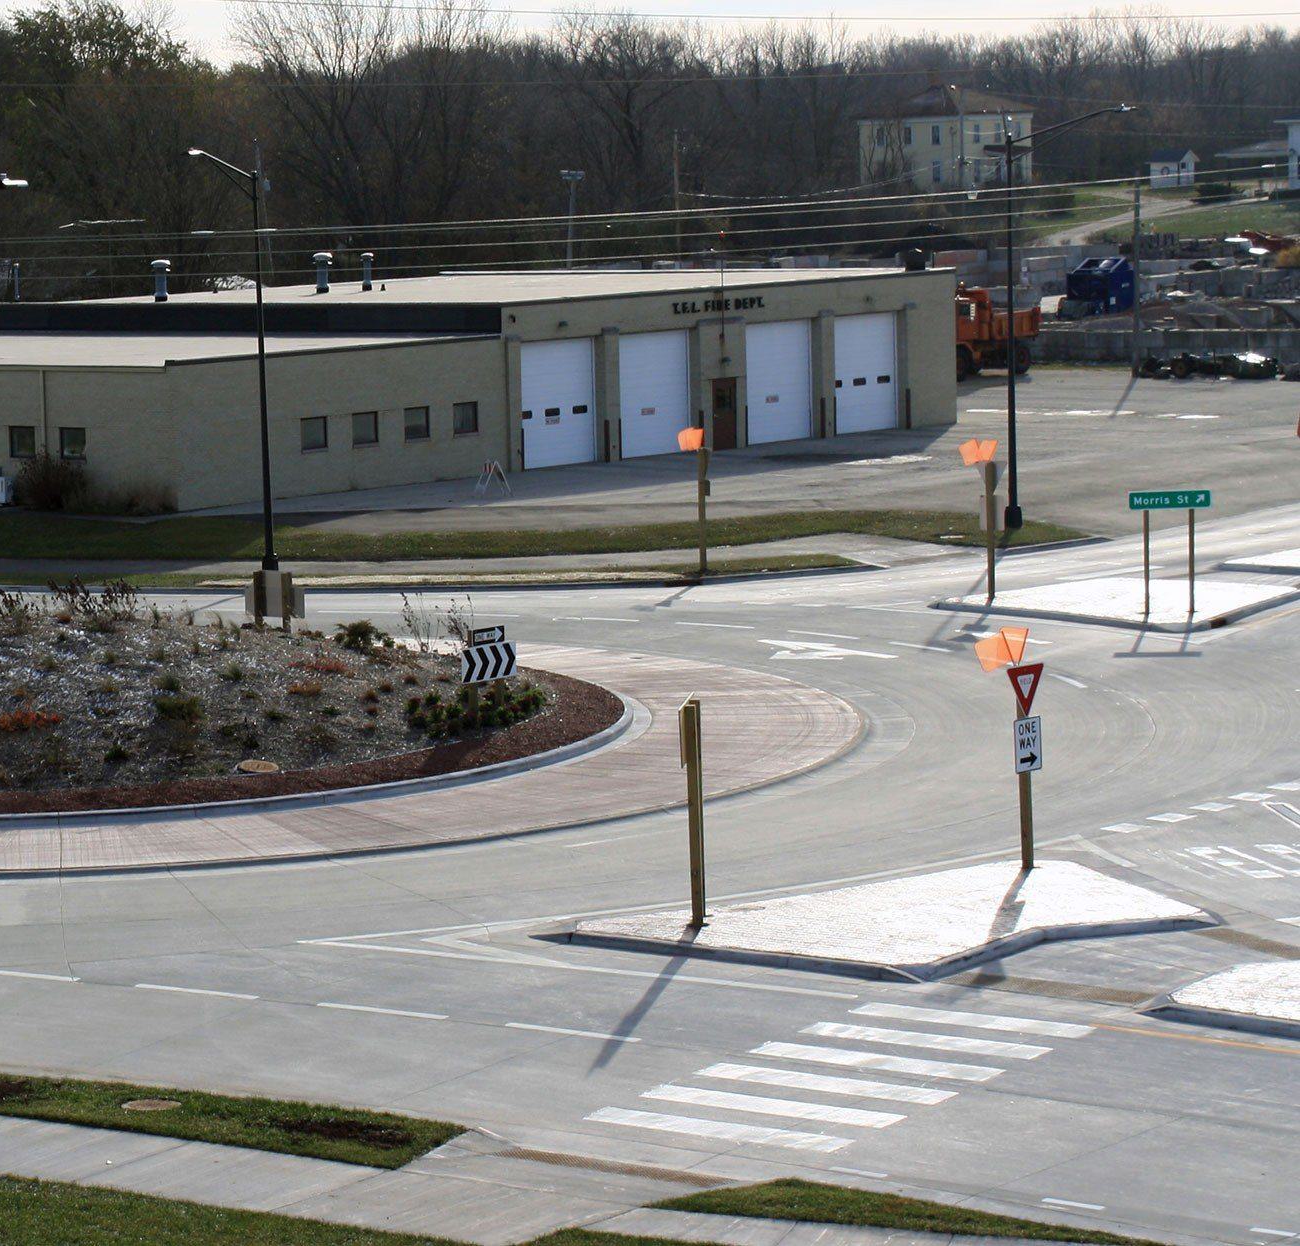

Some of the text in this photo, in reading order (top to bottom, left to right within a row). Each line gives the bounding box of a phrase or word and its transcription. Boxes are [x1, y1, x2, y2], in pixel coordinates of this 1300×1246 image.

[703, 299, 731, 312] FIRE
[1133, 494, 1189, 506] Morris St
[1018, 721, 1037, 736] ONE
[1019, 736, 1037, 750] WAY
